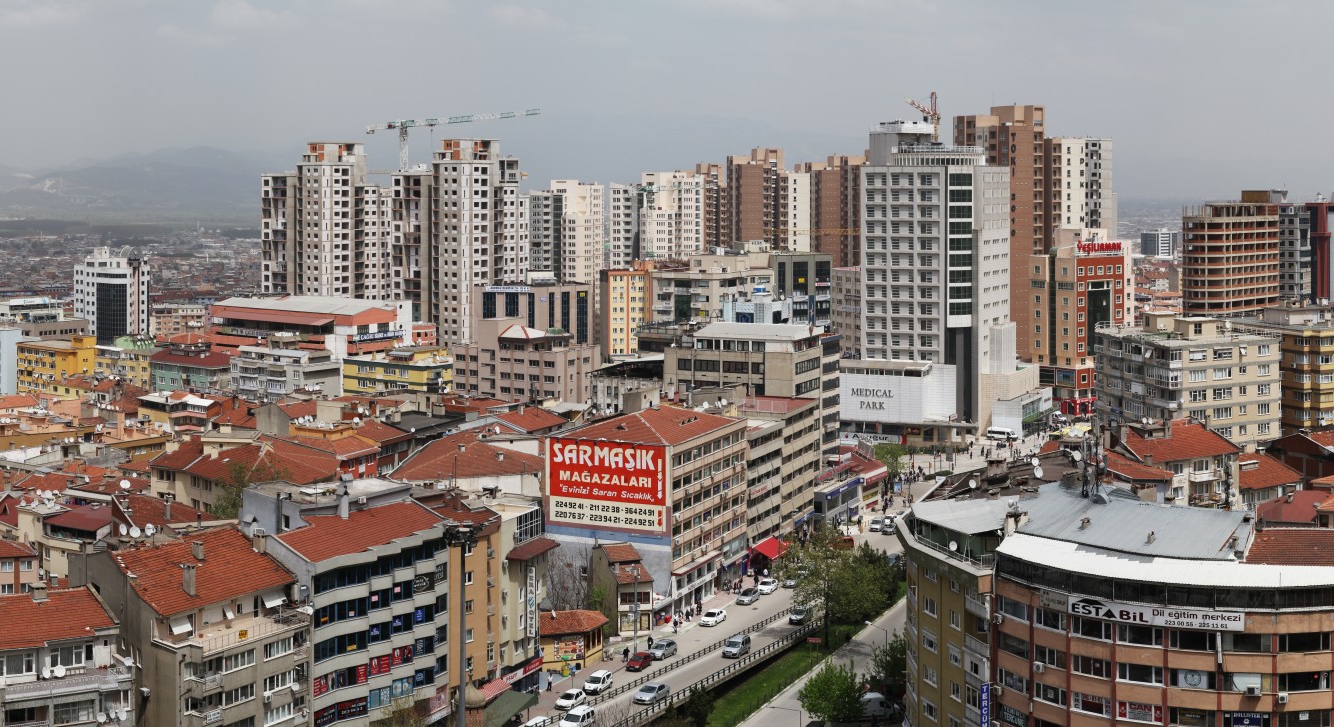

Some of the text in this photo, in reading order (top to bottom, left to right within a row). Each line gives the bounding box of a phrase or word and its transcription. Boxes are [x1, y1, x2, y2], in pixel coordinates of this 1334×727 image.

[851, 388, 894, 398] MEDICAL
[860, 401, 885, 410] PARK
[553, 443, 655, 472] SARMAŞIK
[559, 470, 652, 488] MAĞAZALARI
[592, 488, 618, 497] Saran
[611, 505, 620, 513] 38
[1152, 609, 1165, 617] Dil
[1168, 610, 1198, 621] eğitim
[1201, 612, 1241, 622] merkezi
